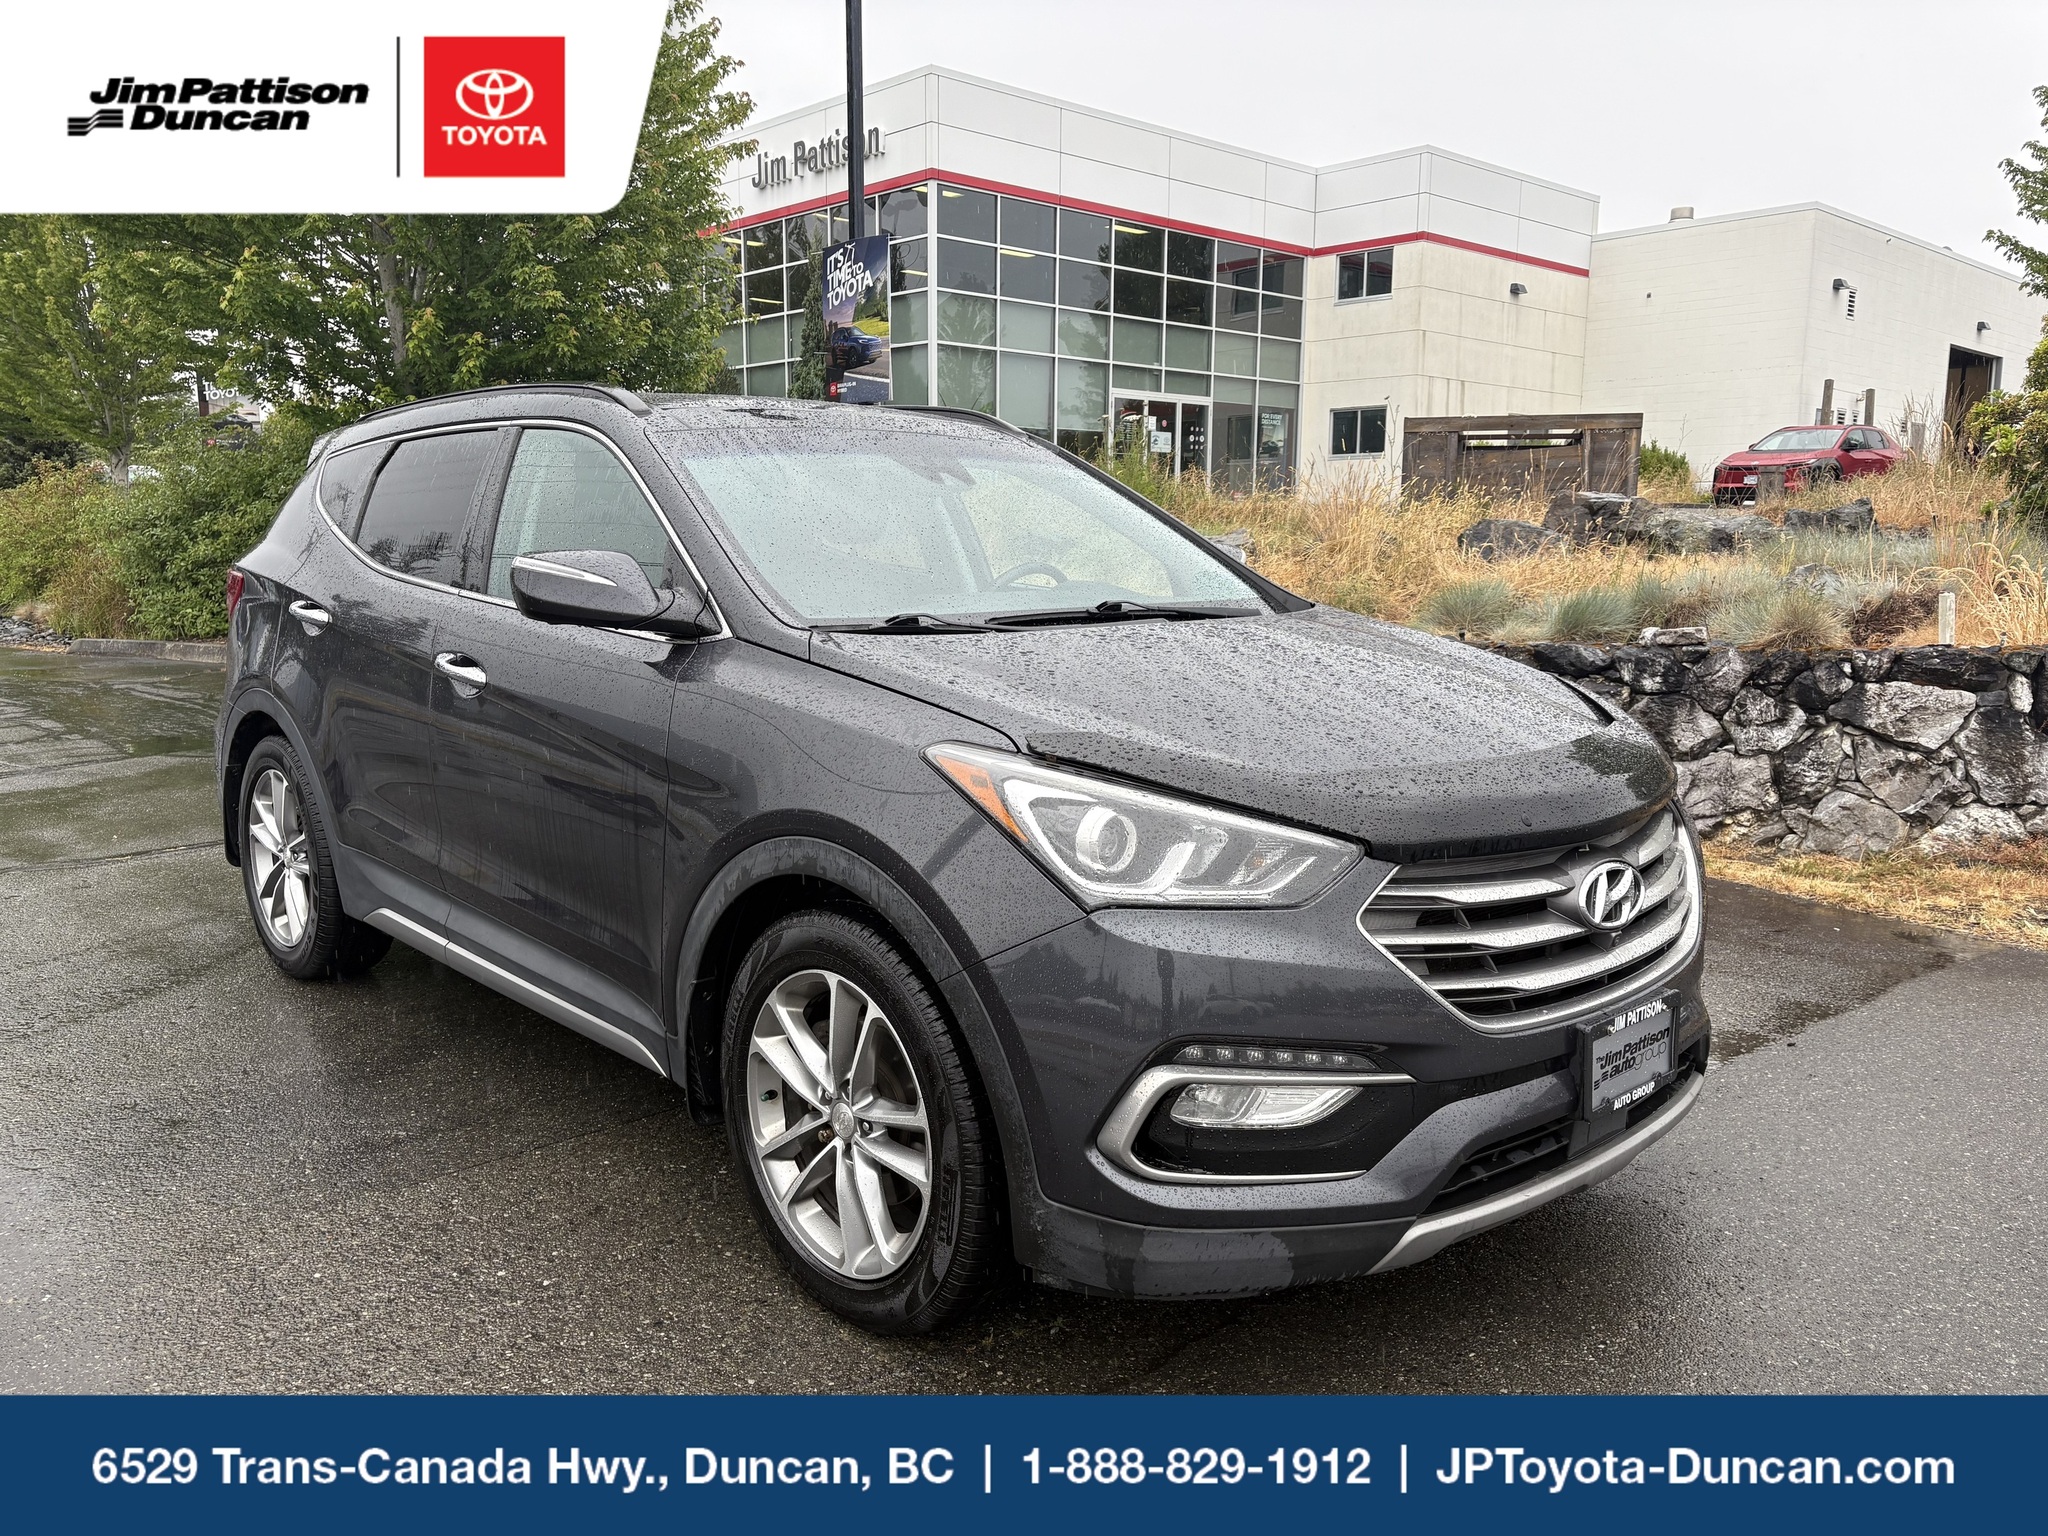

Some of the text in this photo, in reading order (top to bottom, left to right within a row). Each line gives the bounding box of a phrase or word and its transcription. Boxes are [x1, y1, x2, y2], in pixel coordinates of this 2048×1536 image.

[752, 127, 885, 189] Jim Pattisn
[827, 248, 844, 275] IT'S
[827, 261, 852, 291] TIME
[827, 270, 874, 310] TOYOTA
[1613, 999, 1663, 1033] JIM PATTISON
[1613, 1081, 1656, 1111] AUTO GROUP
